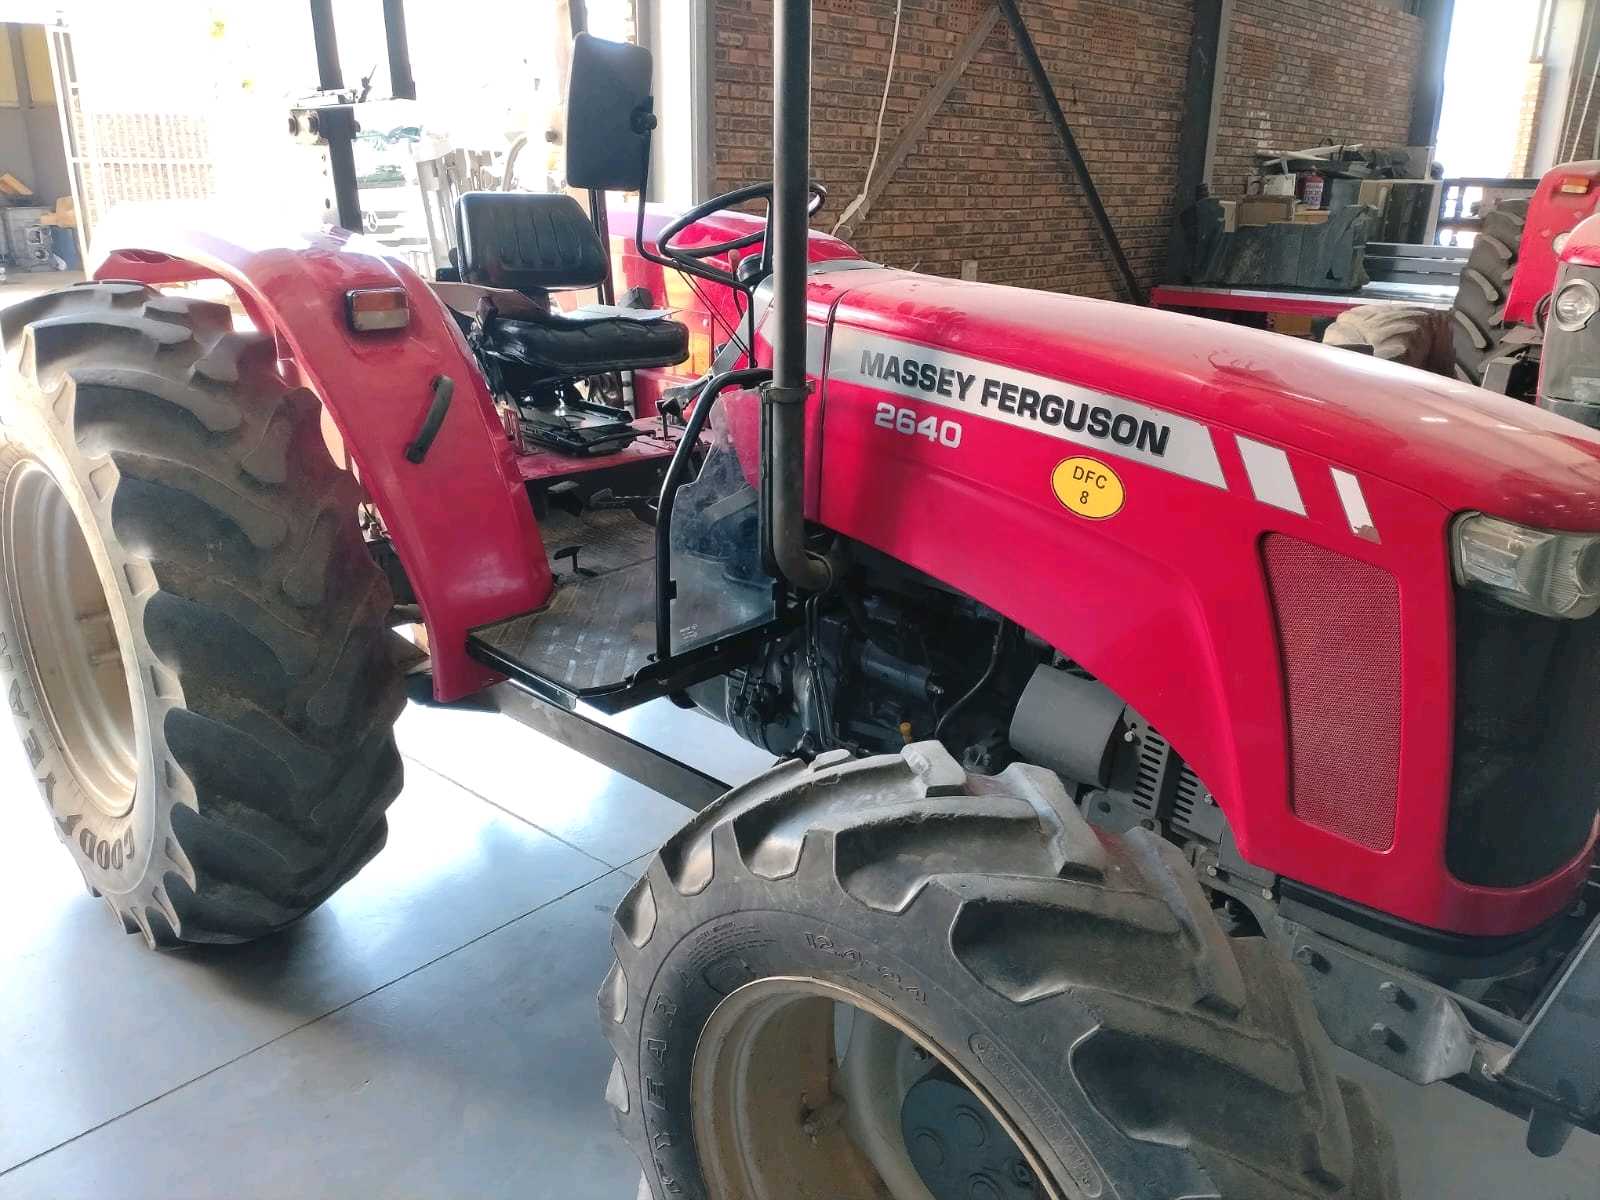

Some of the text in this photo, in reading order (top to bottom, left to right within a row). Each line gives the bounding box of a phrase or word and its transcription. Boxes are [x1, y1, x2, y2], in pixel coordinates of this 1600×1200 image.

[860, 350, 1171, 457] MASSEY FERGUSON
[874, 402, 962, 449] 2640
[1073, 465, 1108, 491] DFC
[1079, 491, 1090, 505] 8
